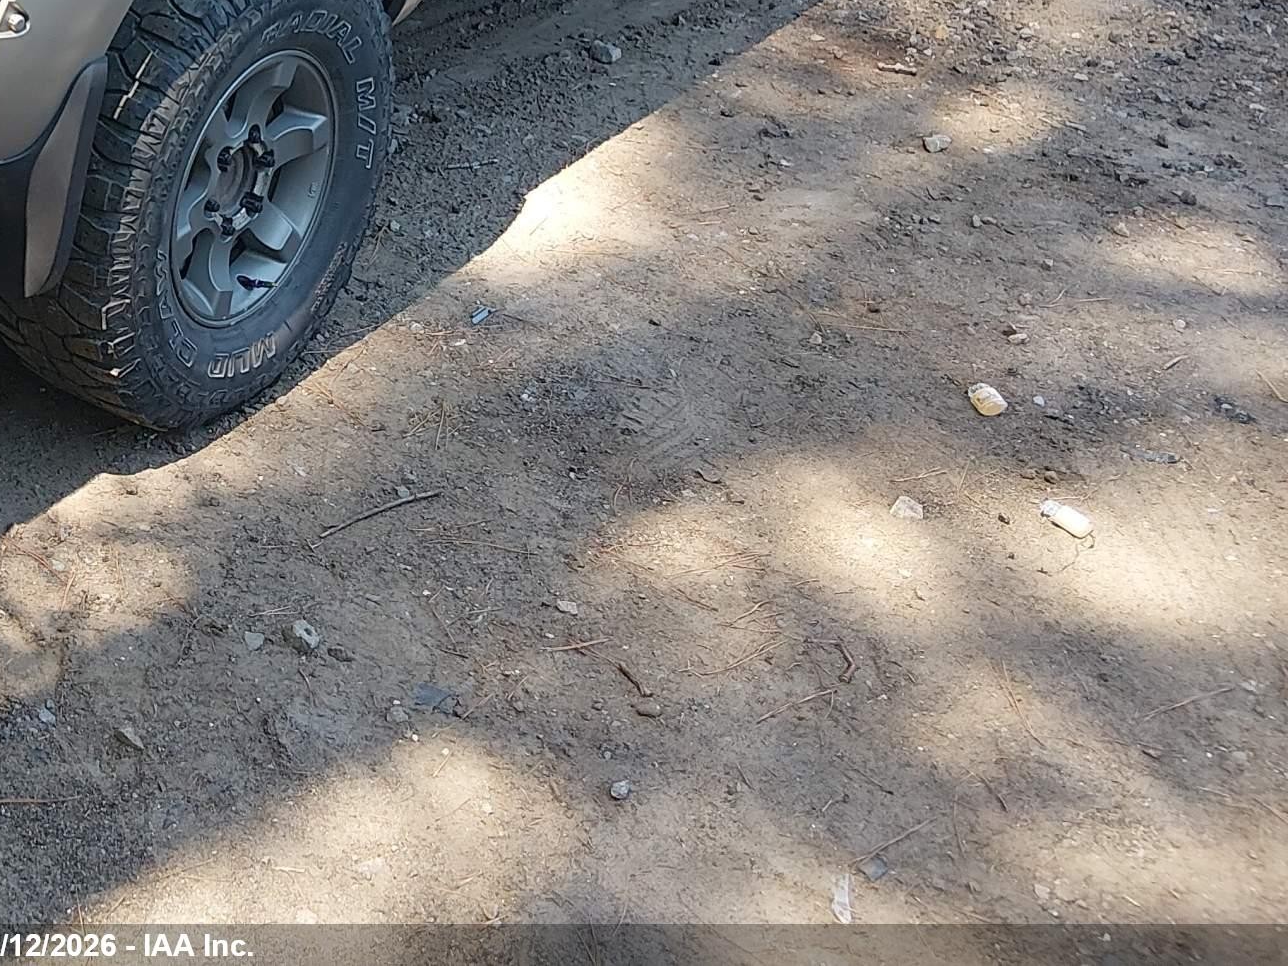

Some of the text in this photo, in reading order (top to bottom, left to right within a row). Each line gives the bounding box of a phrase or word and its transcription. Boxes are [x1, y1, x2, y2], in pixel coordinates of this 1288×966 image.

[261, 10, 377, 169] RADIAL M/T
[208, 332, 276, 378] MUD
